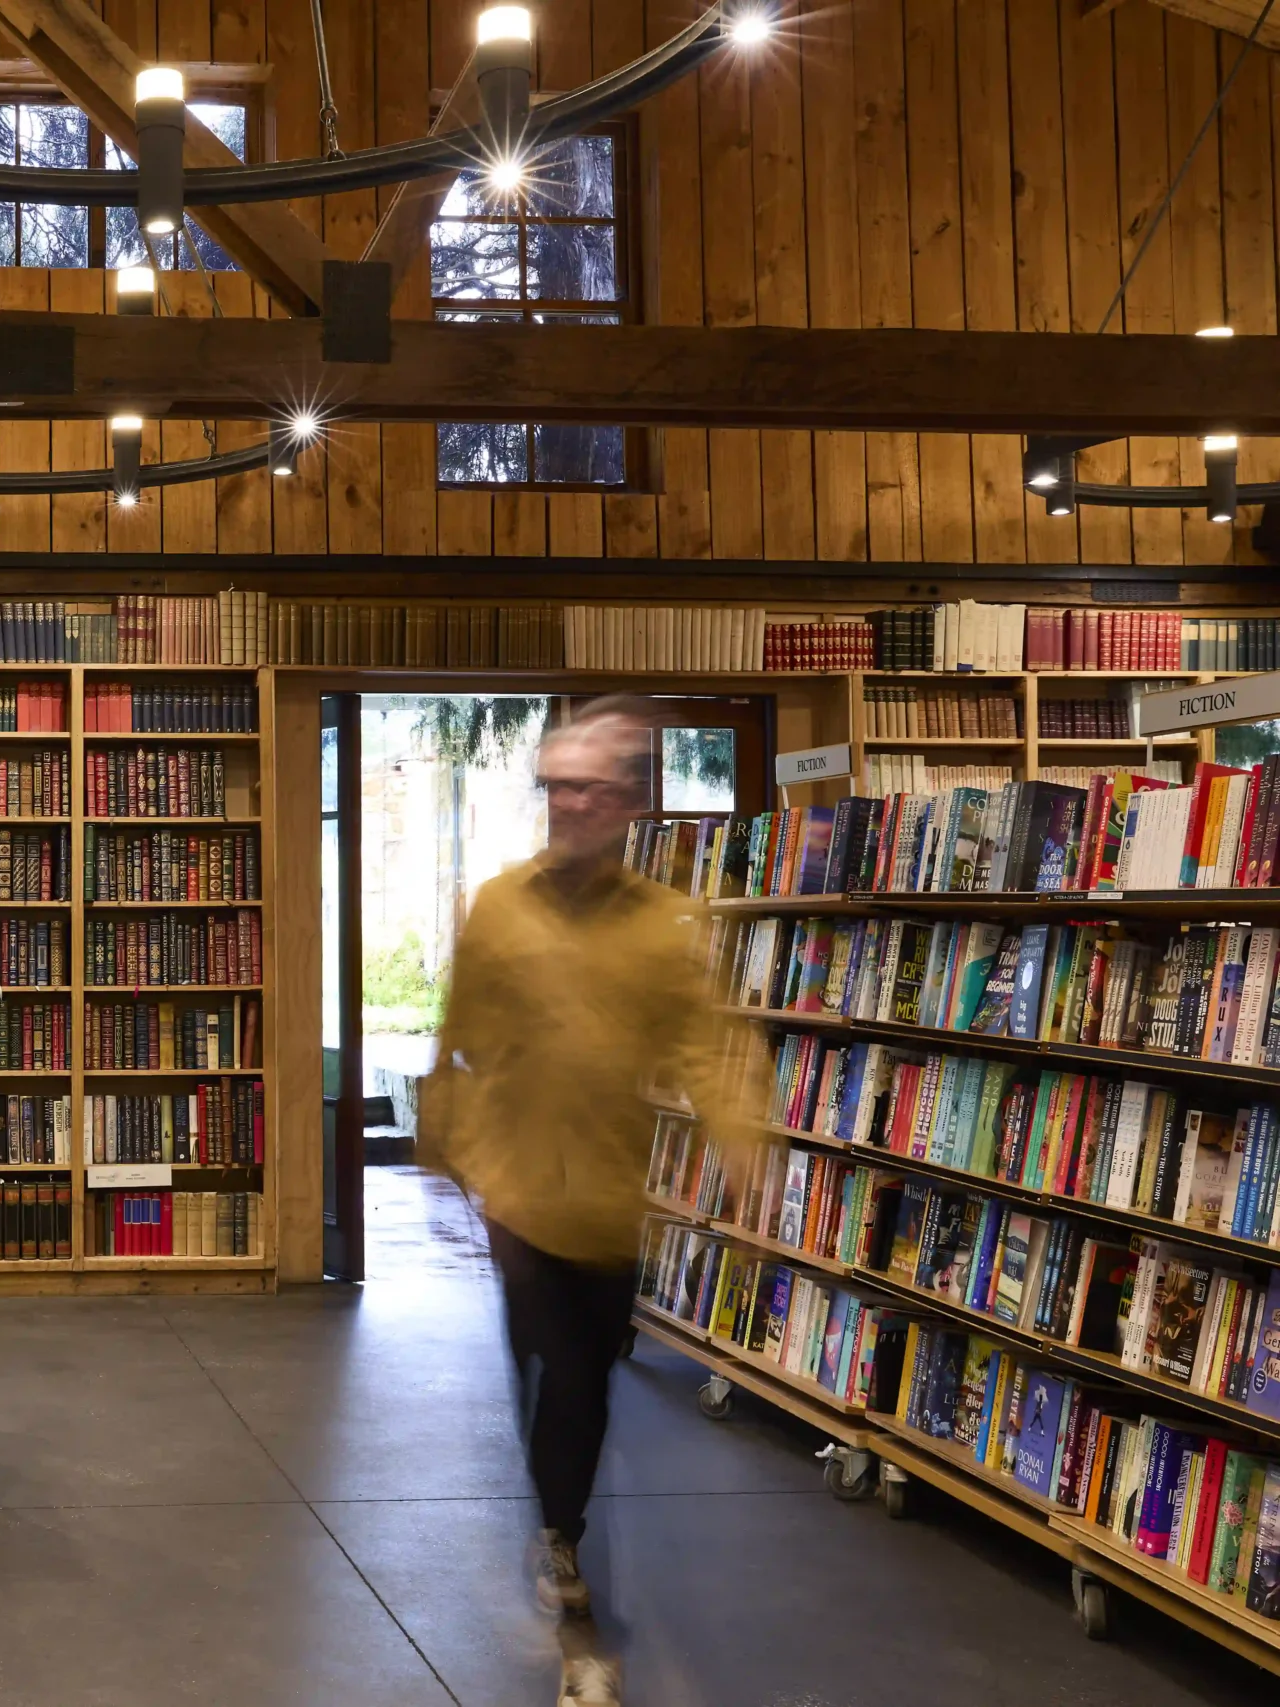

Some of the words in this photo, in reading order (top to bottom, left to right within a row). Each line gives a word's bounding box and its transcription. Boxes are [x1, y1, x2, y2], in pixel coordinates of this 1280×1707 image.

[1179, 691, 1236, 717] FICTION
[797, 755, 827, 773] FICTION
[950, 790, 958, 815] DANIEL
[957, 790, 965, 814] DANIEL
[1105, 796, 1110, 806] GO
[834, 802, 846, 848] Ferrante
[841, 802, 851, 833] Elena
[946, 817, 954, 843] MASON
[952, 817, 961, 842] MASON
[1100, 807, 1108, 830] GENTLE
[1249, 812, 1260, 856] STEDMAN
[1263, 812, 1275, 856] STEDMAN
[1026, 935, 1040, 945] LIANE
[1070, 944, 1079, 984] MORTIMER
[1170, 963, 1181, 974] OF
[1246, 933, 1260, 978] LOVESICK
[1255, 933, 1271, 979] LOVESICK
[1215, 969, 1232, 1042] CRUX
[1240, 984, 1251, 1013] Lillian
[1250, 984, 1262, 1014] Lillian
[1014, 1025, 1027, 1034] truths
[1017, 1012, 1026, 1022] little
[1234, 1018, 1246, 1051] Telford
[1244, 1019, 1257, 1052] Telford
[915, 1056, 933, 1134] Fierceland
[922, 1056, 940, 1135] Fierceland
[1010, 1095, 1018, 1113] MAGGIE
[1101, 1098, 1111, 1127] TREMAIN
[1109, 1099, 1119, 1129] TREMAIN
[1162, 1122, 1172, 1148] BASED
[1246, 1119, 1256, 1156] SUNFLOWER
[1257, 1120, 1268, 1158] SUNFLOWER
[1158, 1155, 1166, 1175] TRUE
[1242, 1156, 1251, 1173] BOYS
[1253, 1158, 1262, 1175] BOYS
[1153, 1176, 1163, 1202] STORY
[1232, 1198, 1244, 1231] WACHMAN
[1244, 1200, 1255, 1234] WACHMAN
[997, 1357, 1008, 1396] PLAYWORLD
[1008, 1367, 1024, 1423] BUCKEYE
[1152, 1427, 1160, 1454] GOOD
[1161, 1431, 1170, 1458] GOOD
[1017, 1448, 1045, 1474] DONAL
[1106, 1446, 1114, 1469] WINTON
[1146, 1455, 1156, 1487] INTENTIONS
[1019, 1463, 1039, 1484] RYAN
[1155, 1459, 1165, 1492] INTENTIONS
[1262, 1498, 1270, 1525] JAMES
[1254, 1527, 1265, 1575] ISLINGTON
